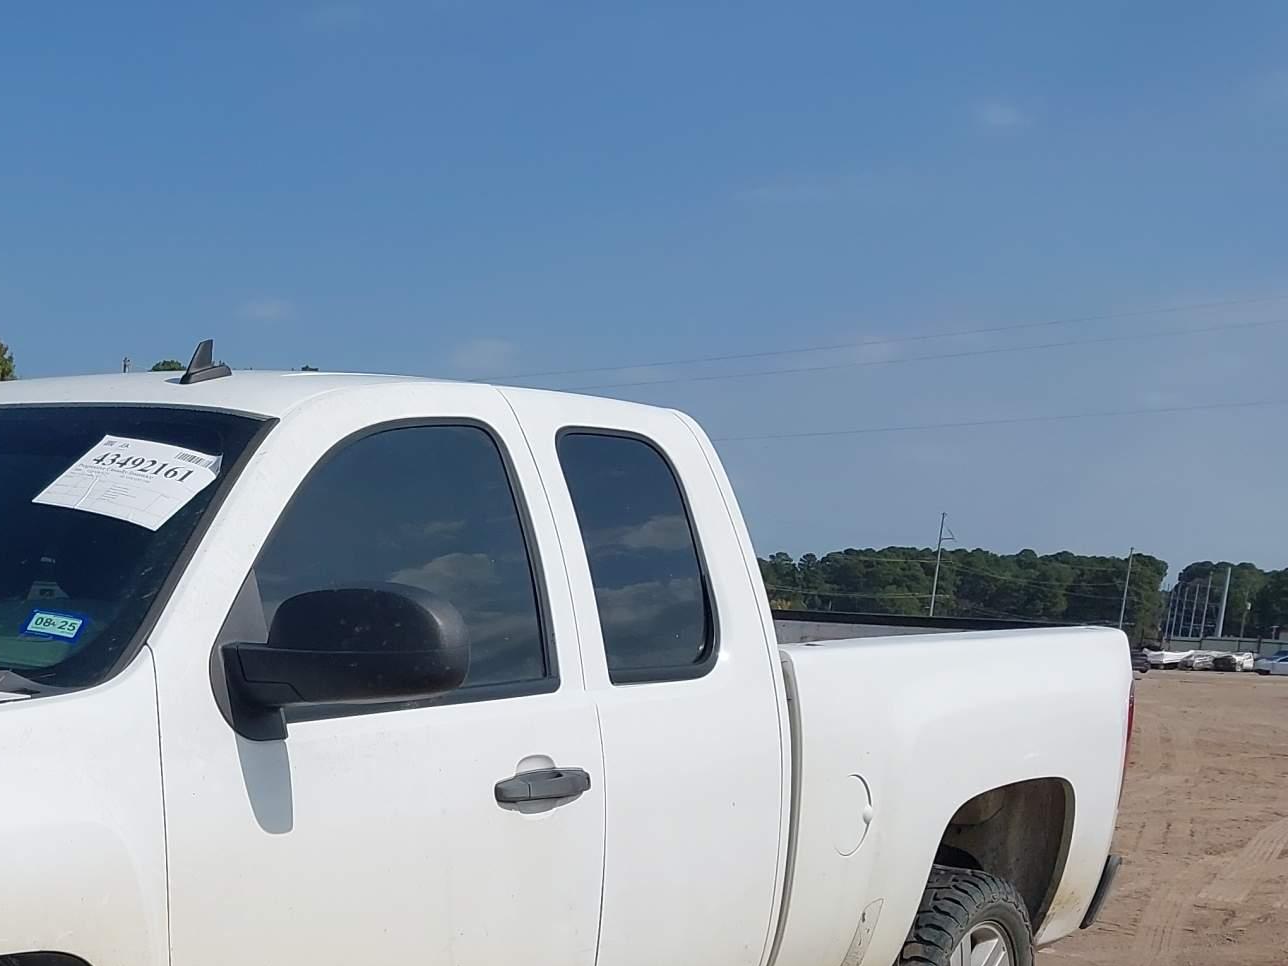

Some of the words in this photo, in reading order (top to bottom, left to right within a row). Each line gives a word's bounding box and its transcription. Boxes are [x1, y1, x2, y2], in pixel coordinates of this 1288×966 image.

[93, 452, 194, 482] 43492161
[34, 616, 52, 627] 08
[57, 620, 77, 631] 25
